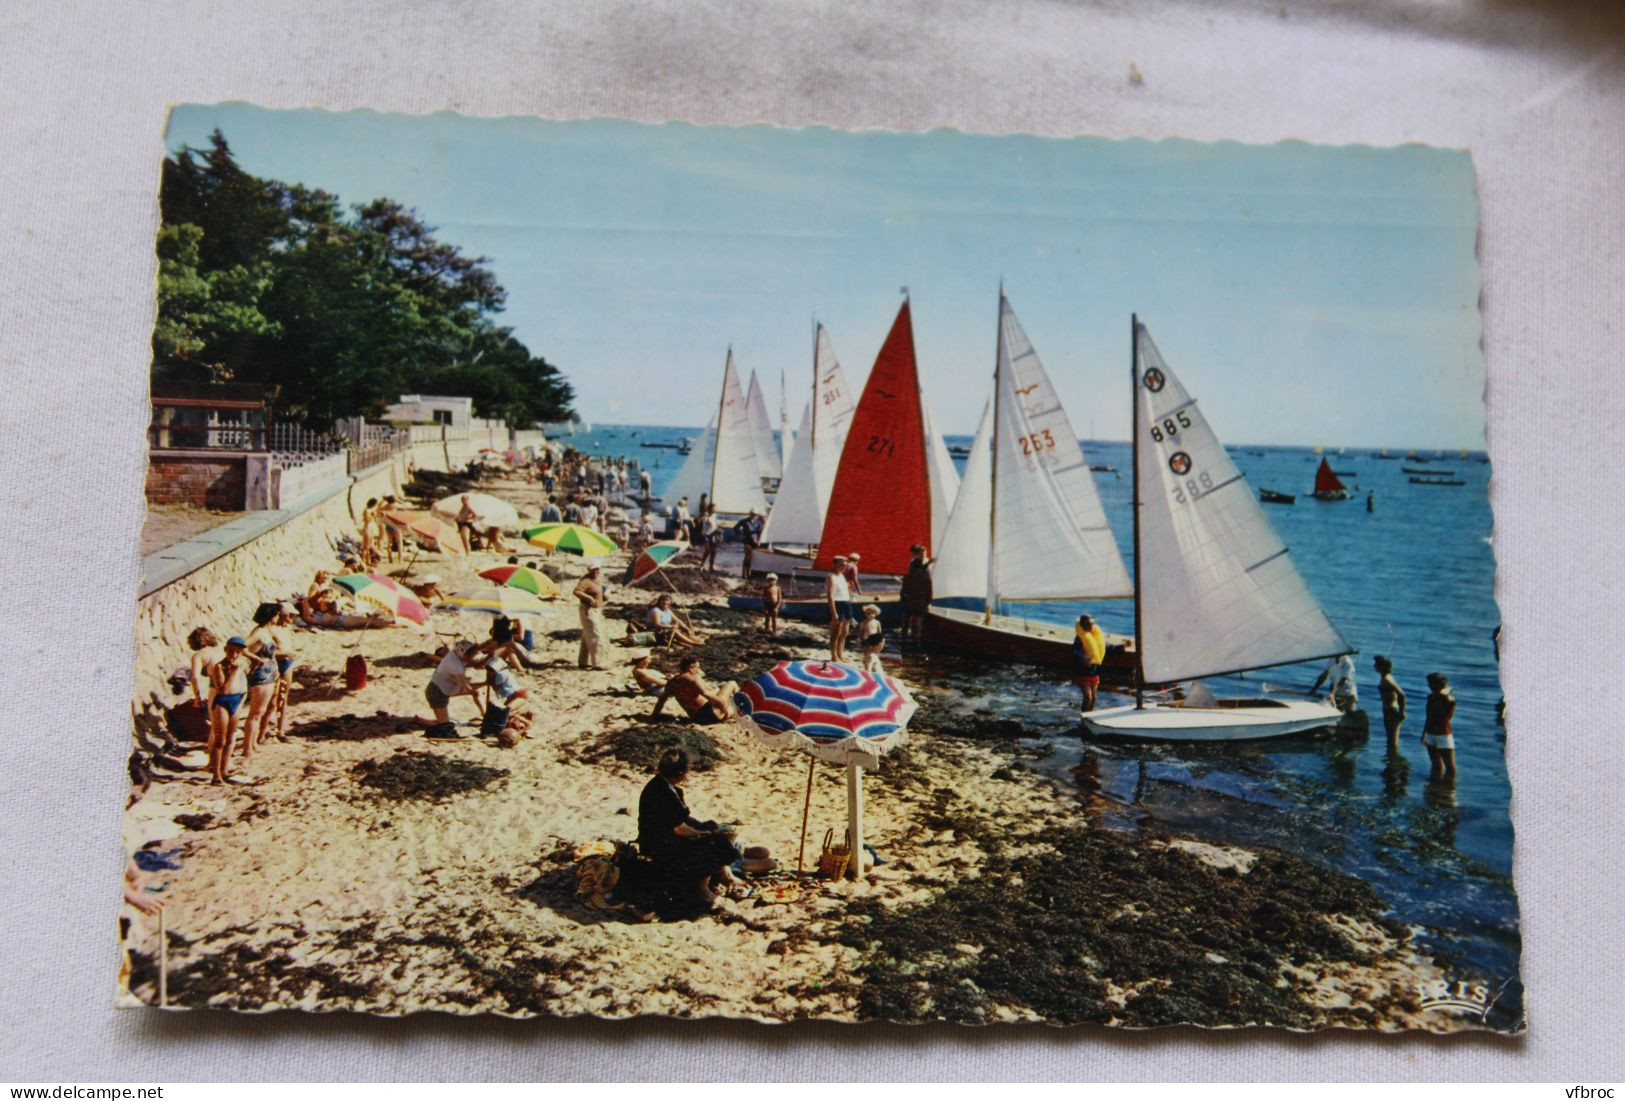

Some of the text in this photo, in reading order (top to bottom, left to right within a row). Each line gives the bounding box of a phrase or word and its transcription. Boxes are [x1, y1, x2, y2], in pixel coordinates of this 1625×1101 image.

[1151, 410, 1191, 442] 885
[867, 435, 896, 457] 271
[1018, 429, 1055, 456] 263
